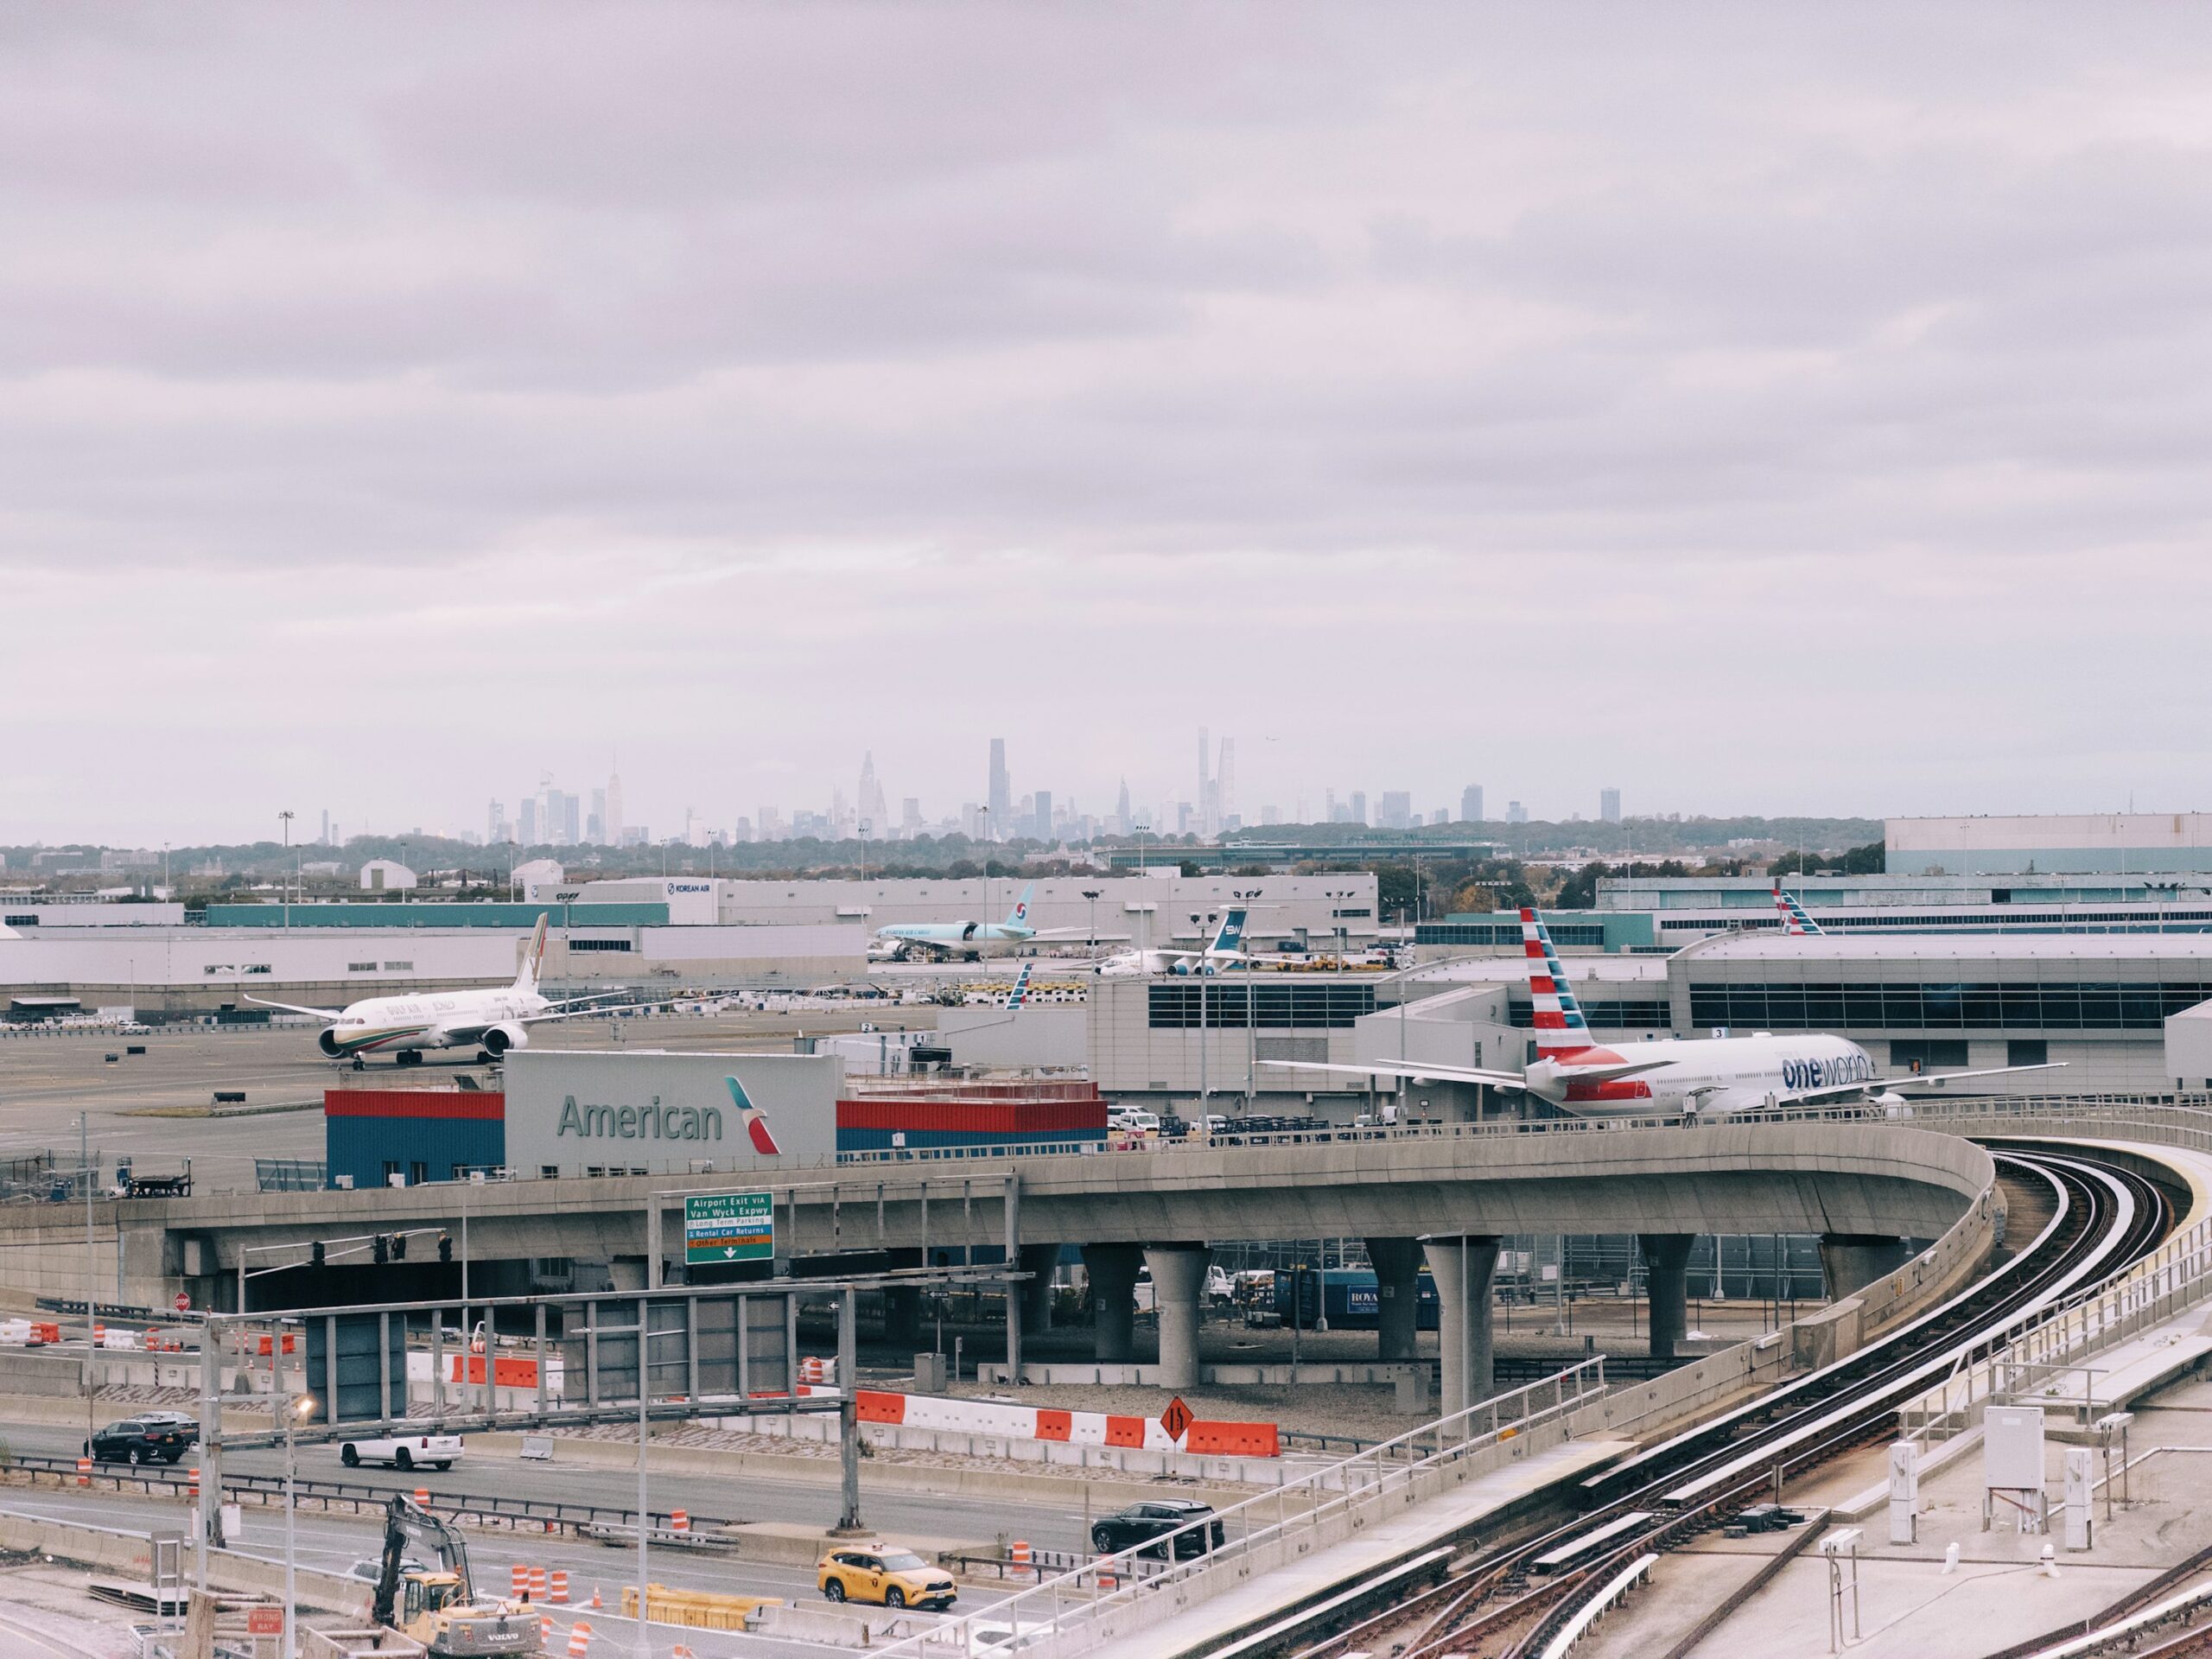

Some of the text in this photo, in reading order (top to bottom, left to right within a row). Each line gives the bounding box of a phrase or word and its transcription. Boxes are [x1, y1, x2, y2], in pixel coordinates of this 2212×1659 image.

[386, 1005, 407, 1015] GULF
[408, 1003, 422, 1014] AIR
[1782, 1046, 1869, 1089] oneworld
[556, 1095, 722, 1141] American
[693, 1199, 726, 1209] Airport
[730, 1197, 747, 1205] Exit
[712, 1208, 734, 1218] Wyck
[739, 1207, 768, 1217] Expwy
[721, 1236, 756, 1245] Terminals
[1351, 1293, 1378, 1301] ROYA
[251, 1613, 281, 1622] WRONG
[257, 1623, 274, 1631] WAY
